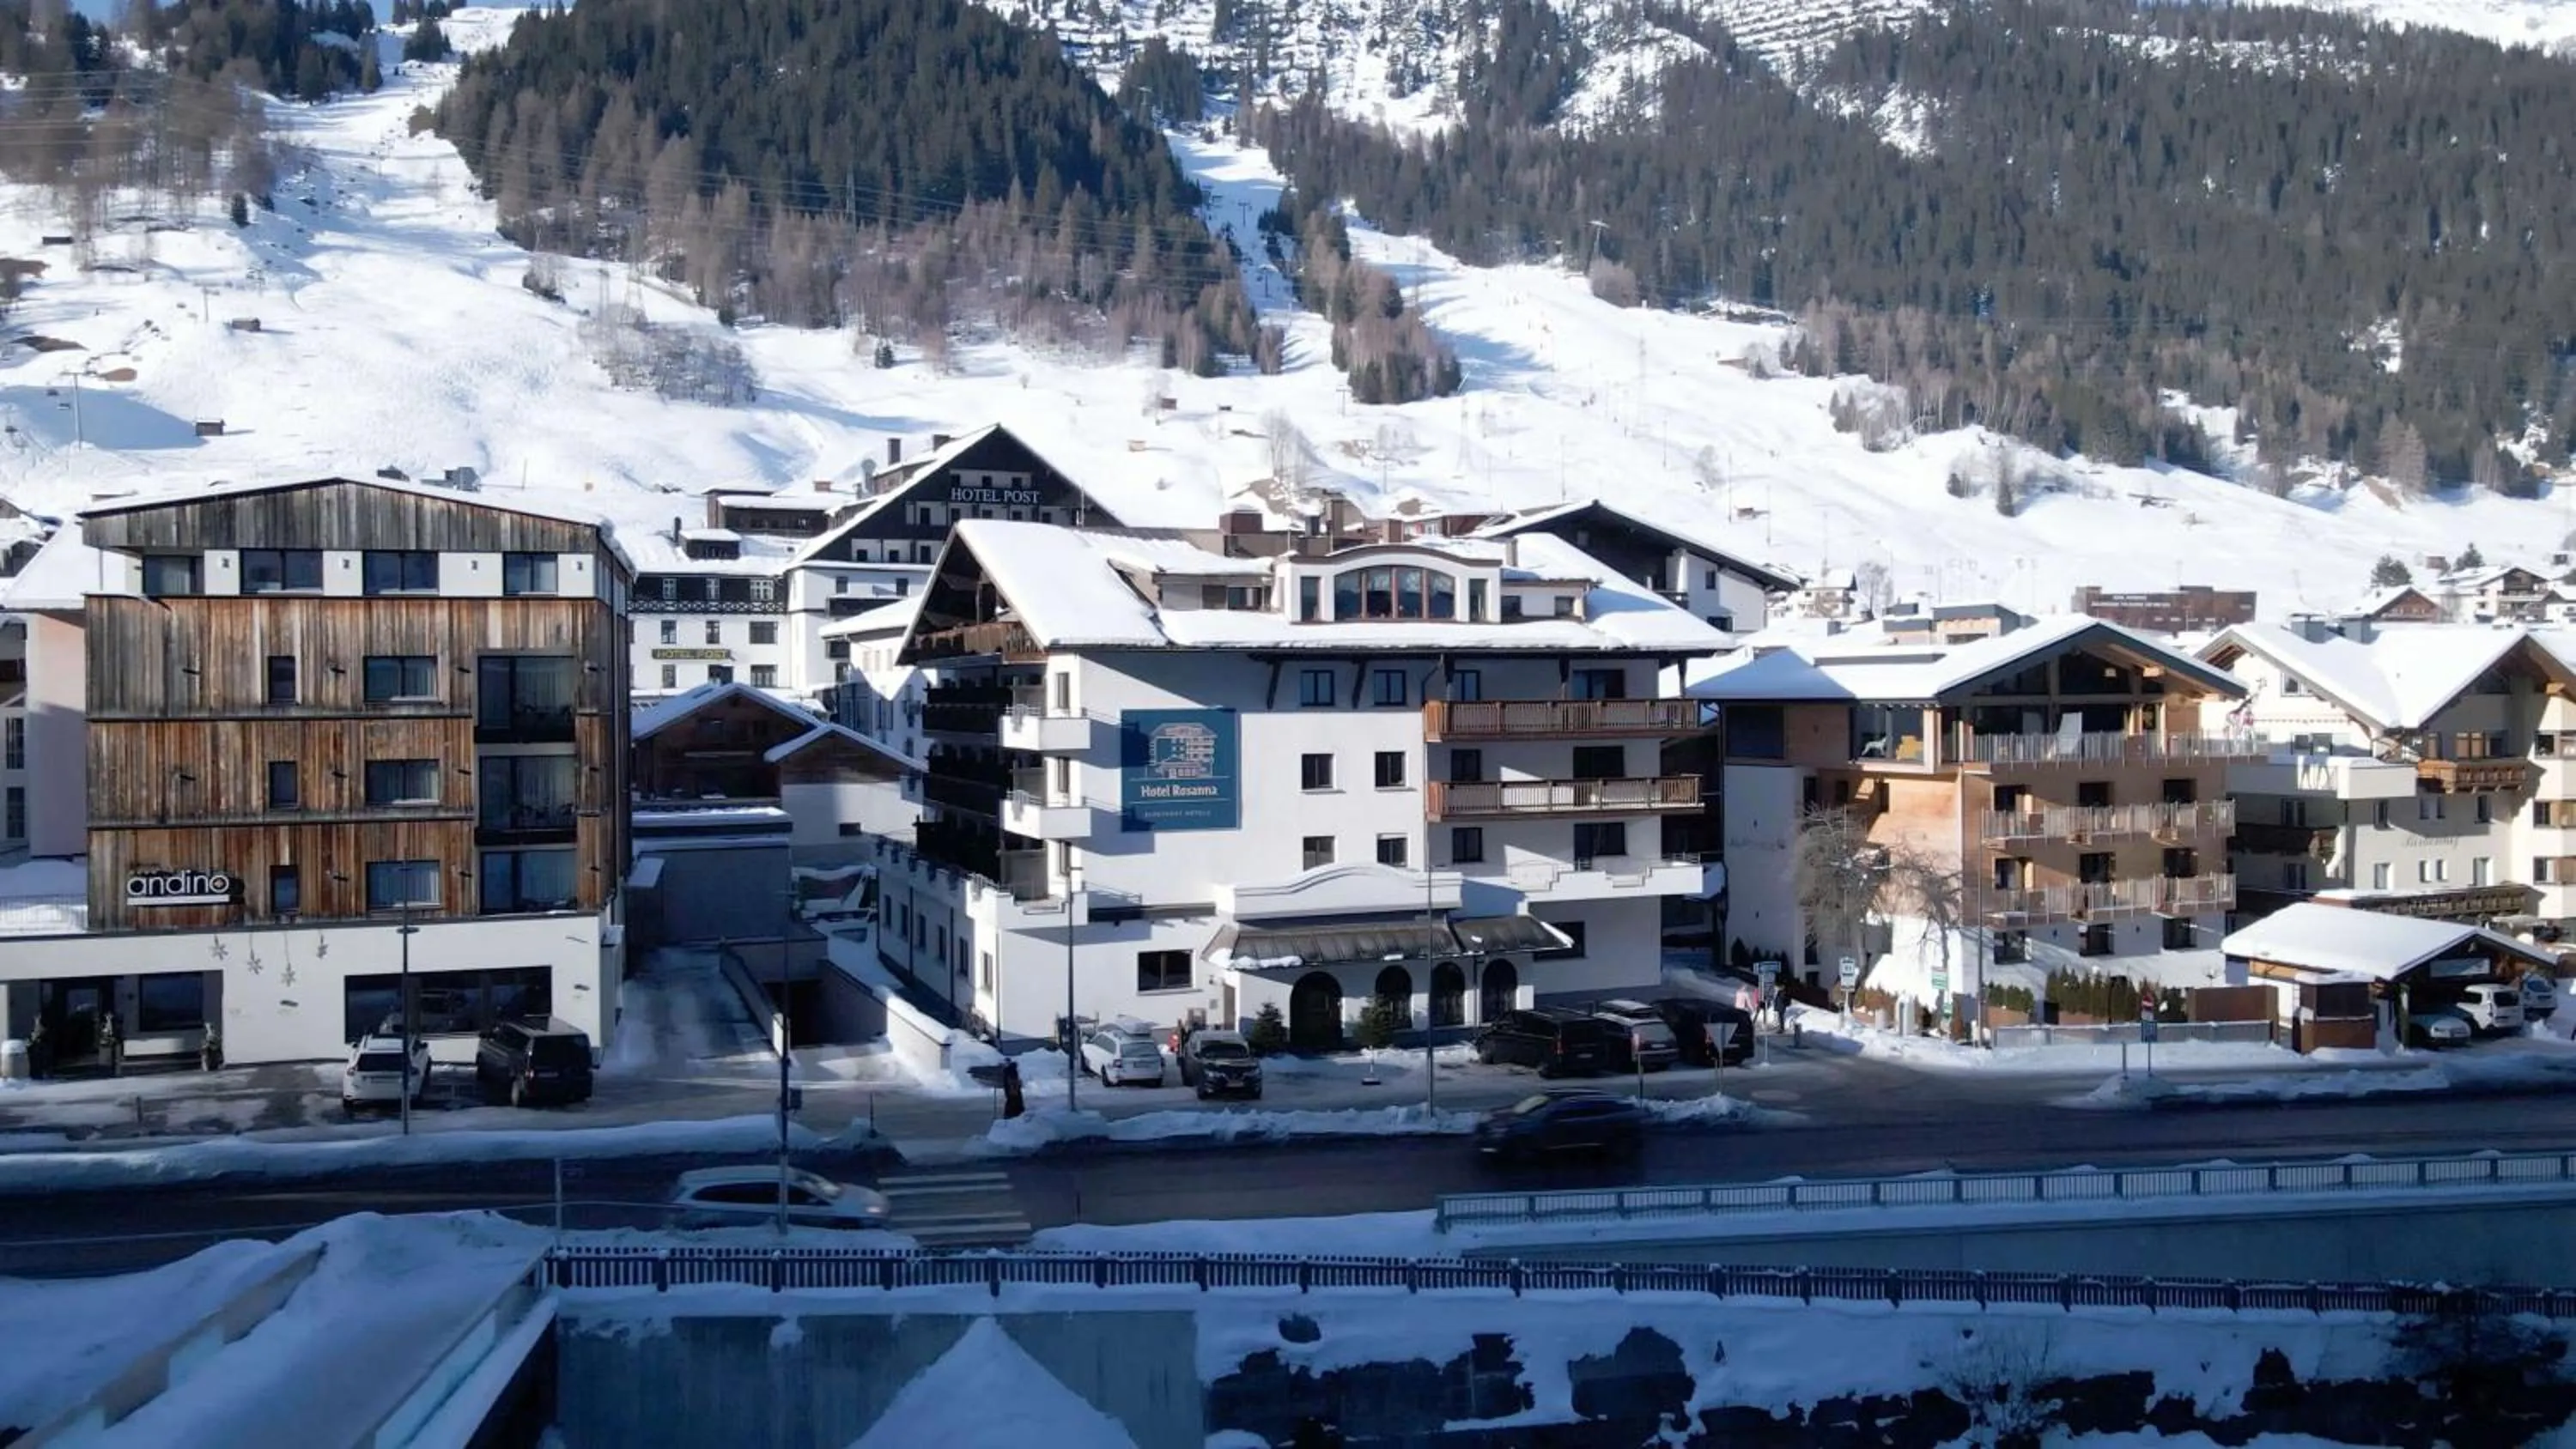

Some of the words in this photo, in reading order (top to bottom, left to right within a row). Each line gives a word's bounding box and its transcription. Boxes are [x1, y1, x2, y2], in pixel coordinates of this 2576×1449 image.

[951, 487, 1000, 502] HOTEL
[1004, 490, 1040, 504] POST
[657, 650, 694, 658] HOTEL
[697, 650, 726, 659] POST
[1140, 784, 1170, 797] Hotel
[1172, 785, 1218, 797] Rosanna
[127, 869, 229, 895] andino
